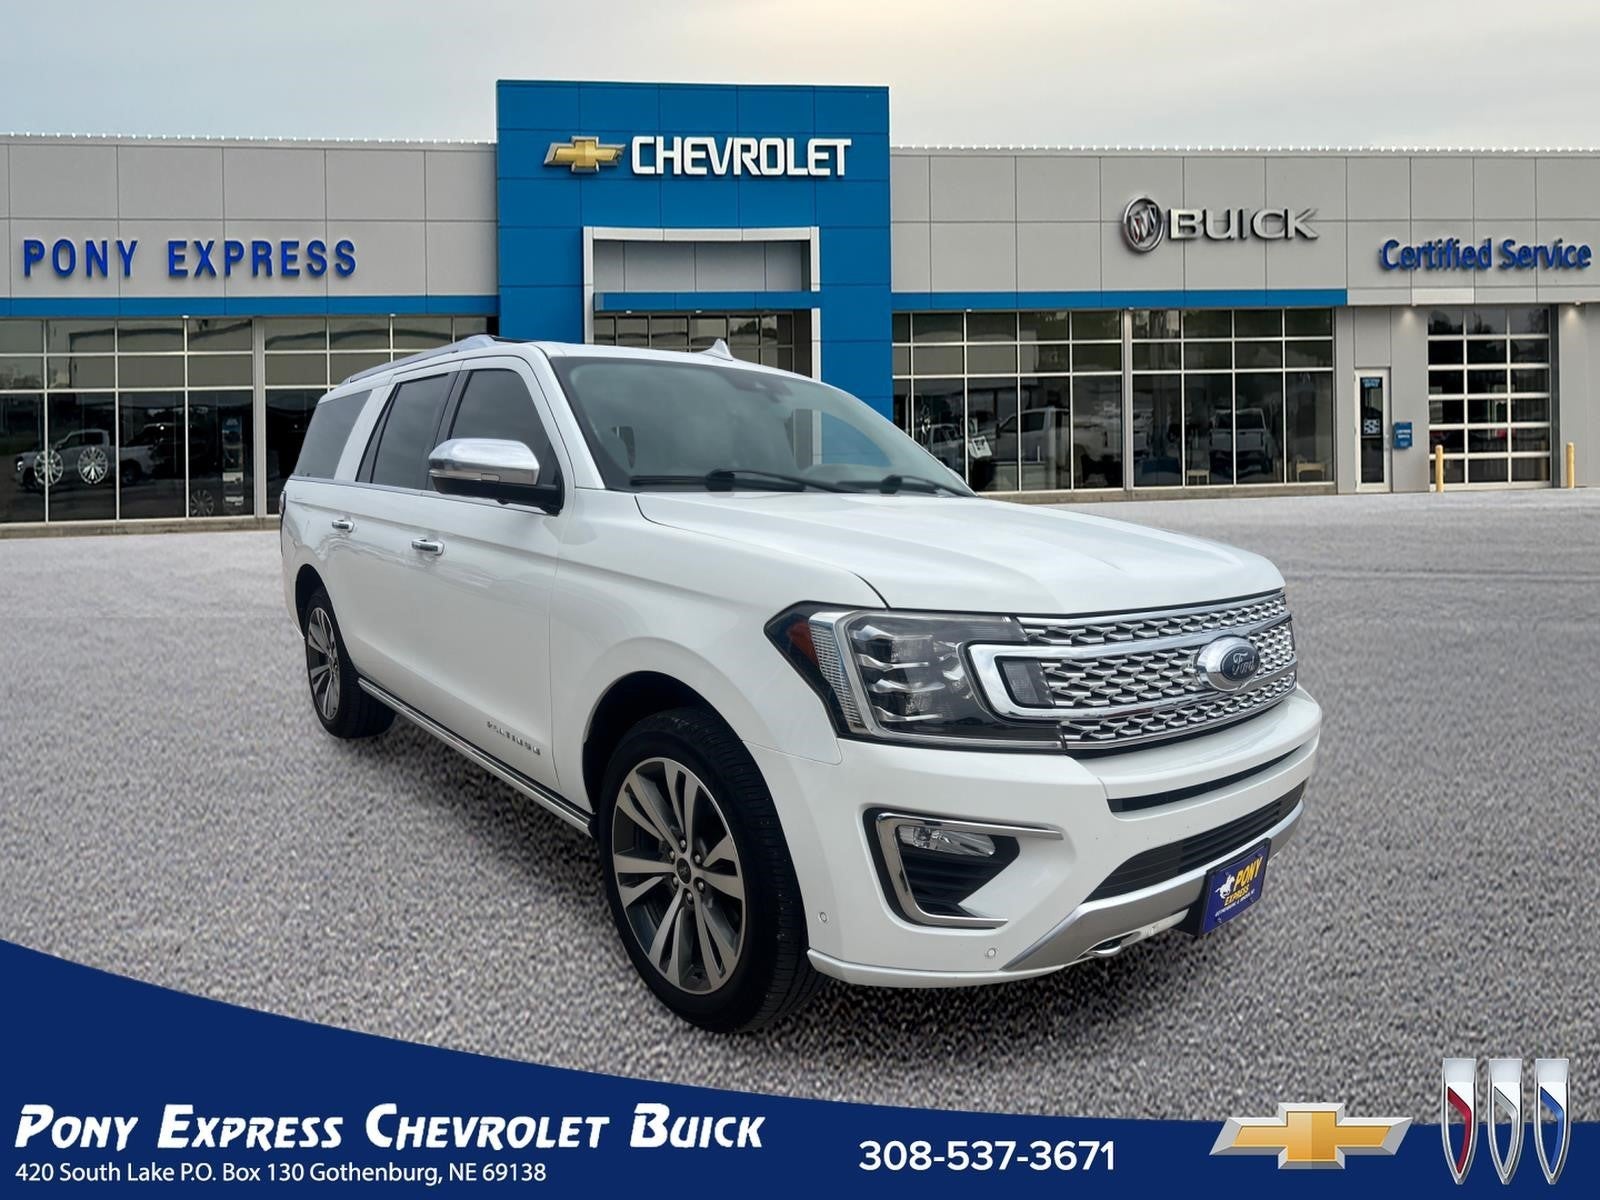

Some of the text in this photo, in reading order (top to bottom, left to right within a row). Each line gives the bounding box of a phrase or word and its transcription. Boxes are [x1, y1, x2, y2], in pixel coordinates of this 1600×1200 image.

[631, 135, 852, 176] CHEVROLET
[1170, 208, 1319, 240] BUICK
[23, 239, 356, 277] PONY EXPRESS
[1382, 238, 1592, 269] Certified Service
[1232, 651, 1256, 676] Ford
[1233, 856, 1264, 891] PONY
